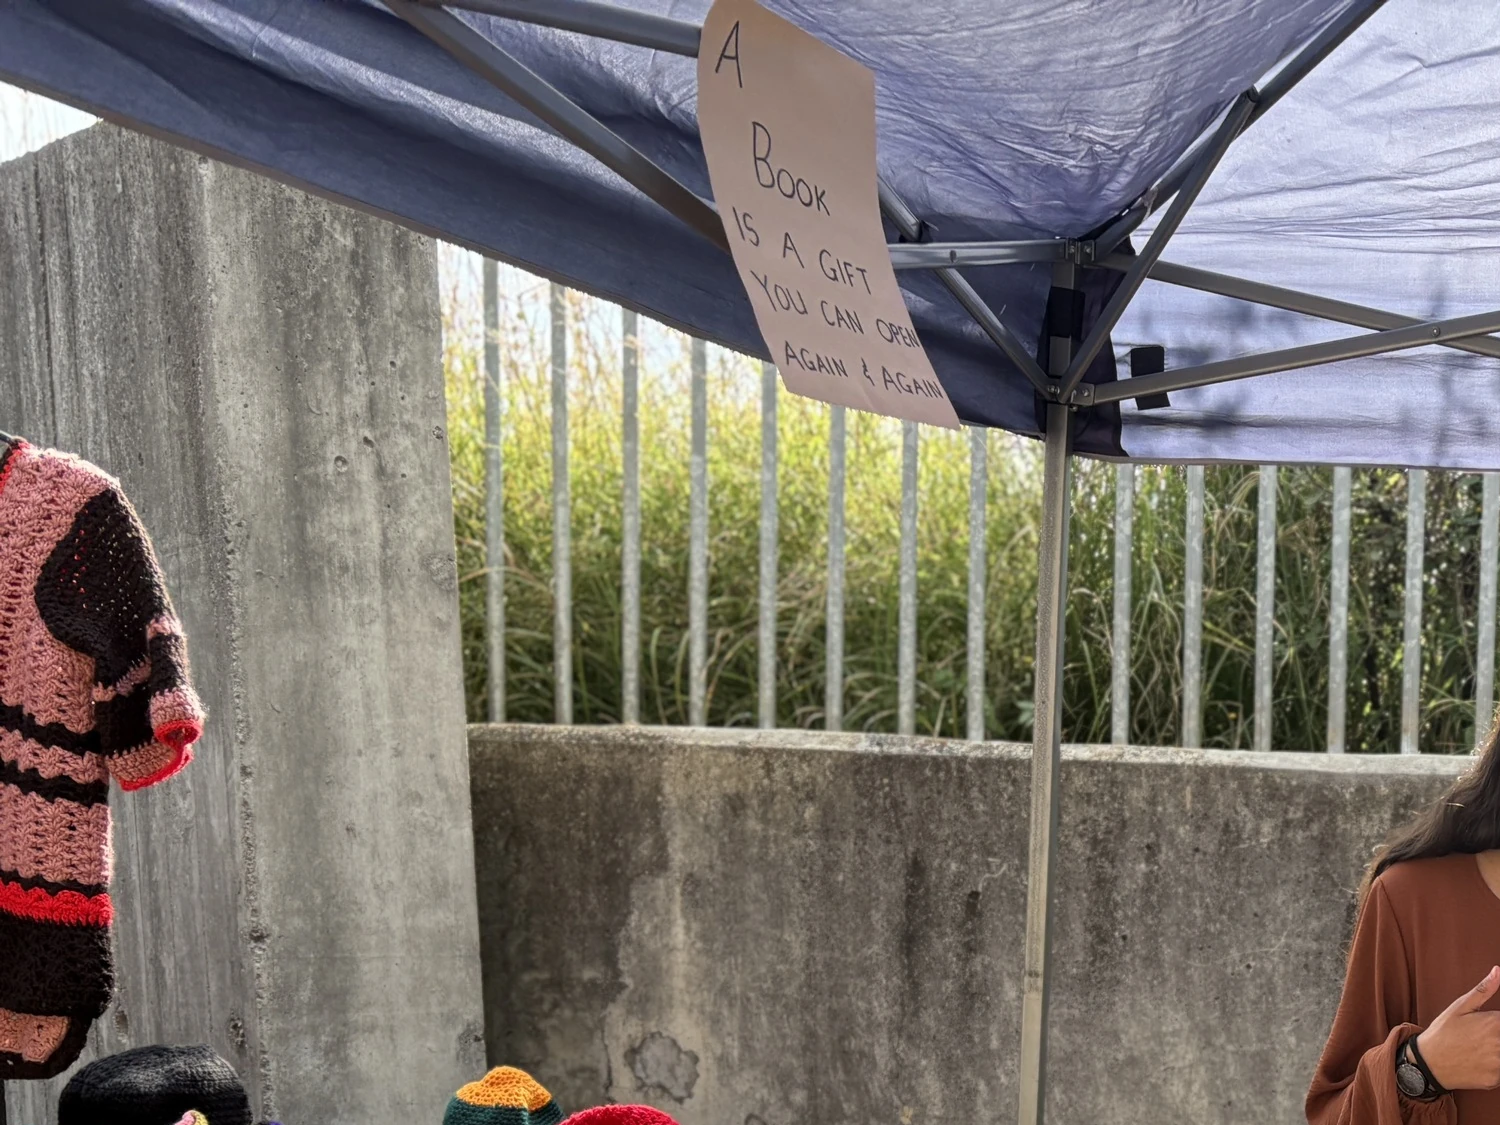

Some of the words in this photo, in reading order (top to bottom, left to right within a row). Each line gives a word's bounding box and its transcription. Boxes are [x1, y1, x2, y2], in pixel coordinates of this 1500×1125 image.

[715, 20, 743, 88] A
[732, 207, 761, 247] IS
[782, 232, 805, 269] A
[819, 249, 872, 295] GIFT
[751, 270, 808, 316] YOU
[821, 301, 865, 336] CAN
[876, 318, 921, 349] OPEN
[785, 340, 849, 379] AGAIN
[862, 365, 873, 387] &
[882, 371, 943, 400] AGAIN
